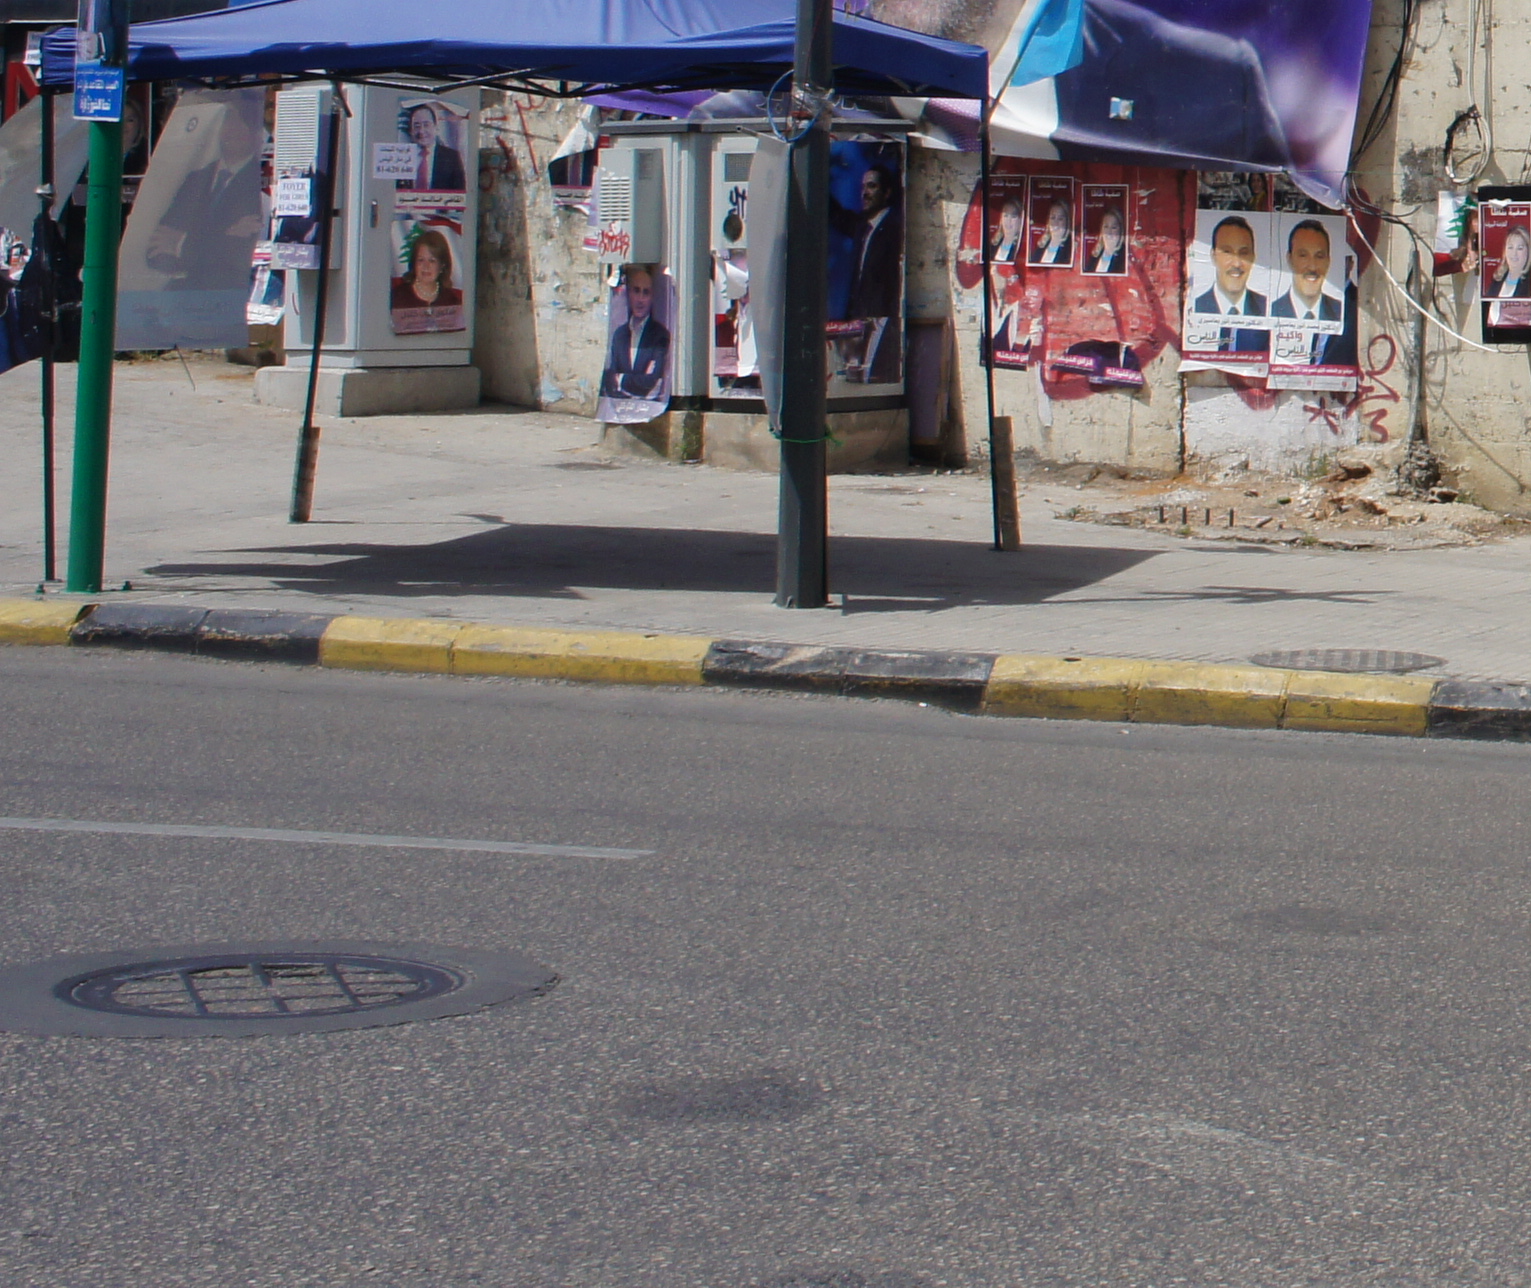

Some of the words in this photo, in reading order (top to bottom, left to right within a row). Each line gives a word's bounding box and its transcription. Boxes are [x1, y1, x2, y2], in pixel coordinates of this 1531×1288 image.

[1508, 207, 1528, 218] صفية
[1187, 331, 1217, 344] الناس
[1276, 345, 1305, 357] الناس
